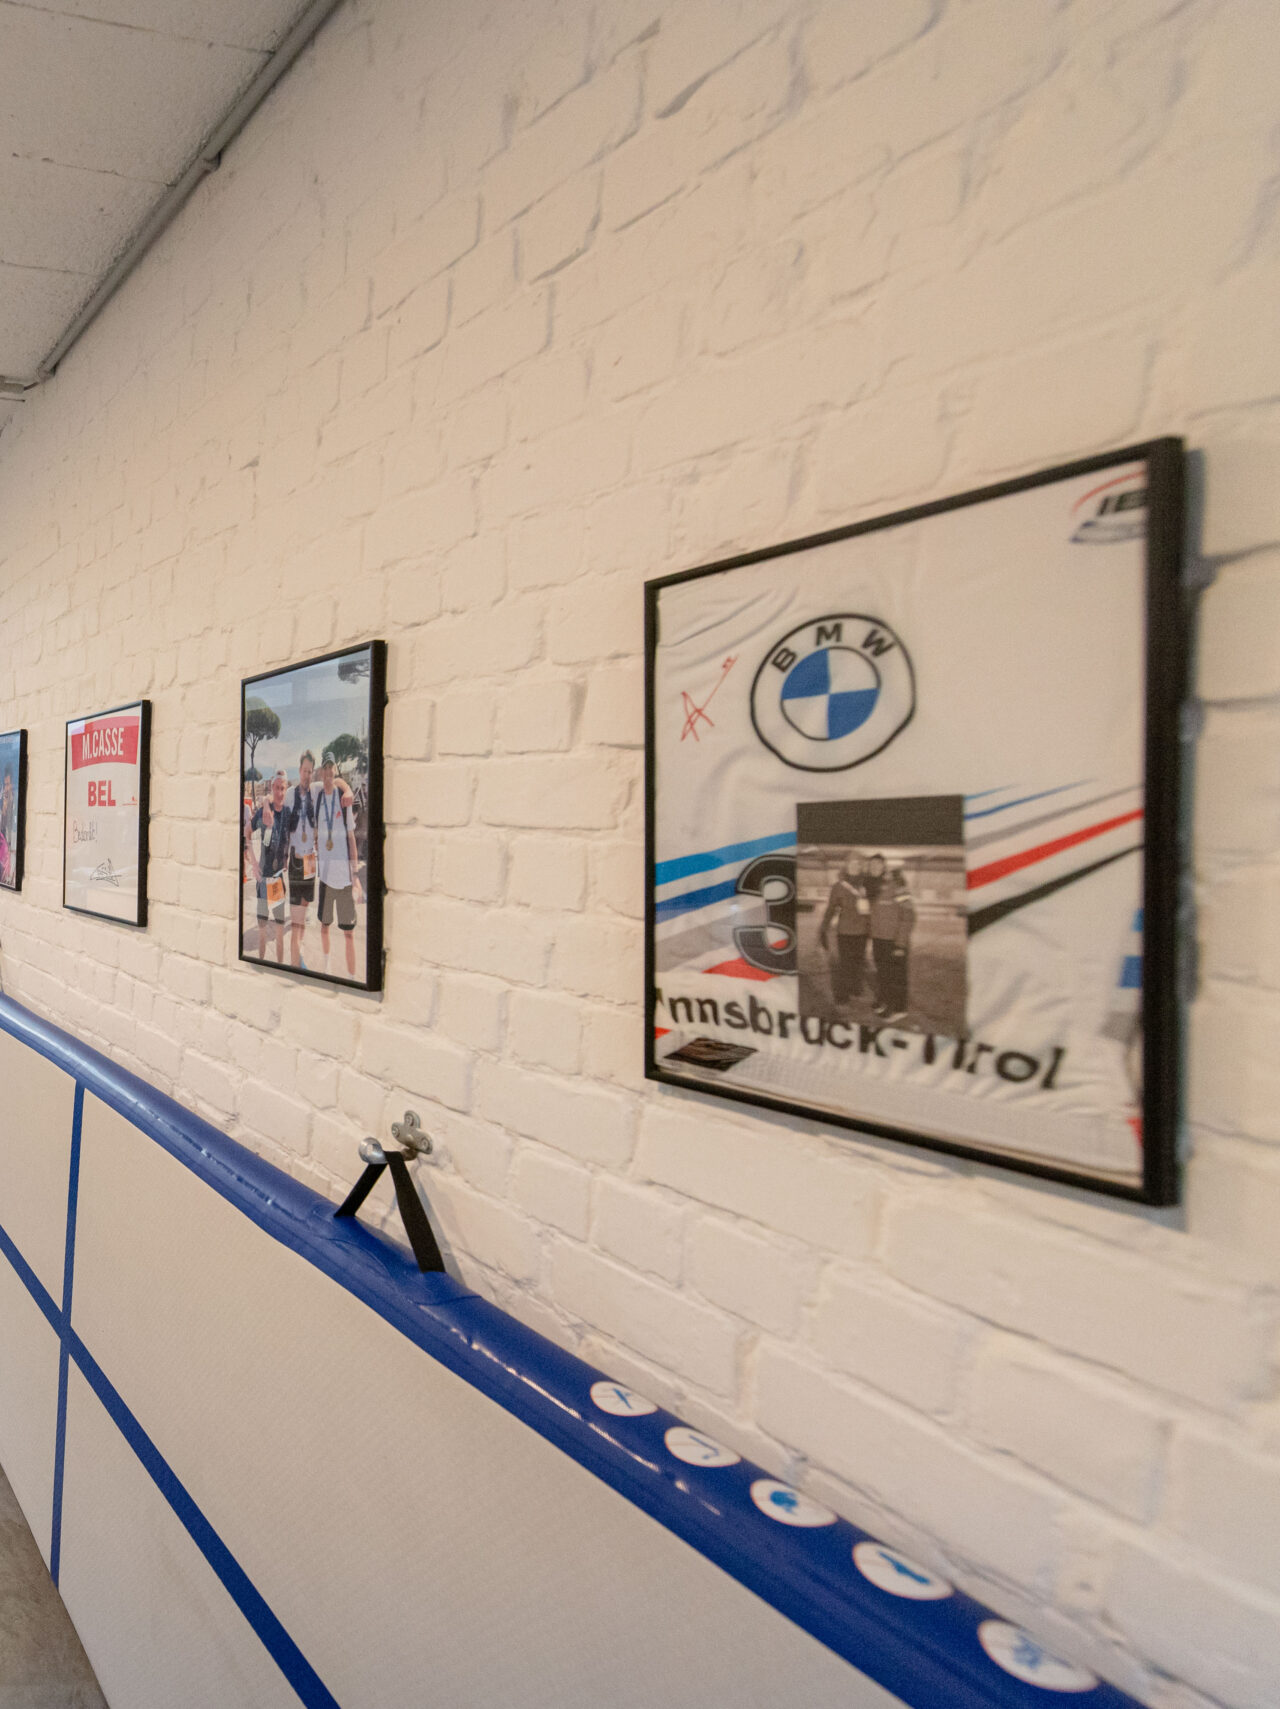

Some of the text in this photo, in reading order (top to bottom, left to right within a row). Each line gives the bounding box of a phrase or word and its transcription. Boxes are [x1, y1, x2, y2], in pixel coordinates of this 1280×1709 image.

[771, 622, 898, 673] BMW
[82, 727, 125, 760] M.CASSE
[87, 780, 117, 807] BEL
